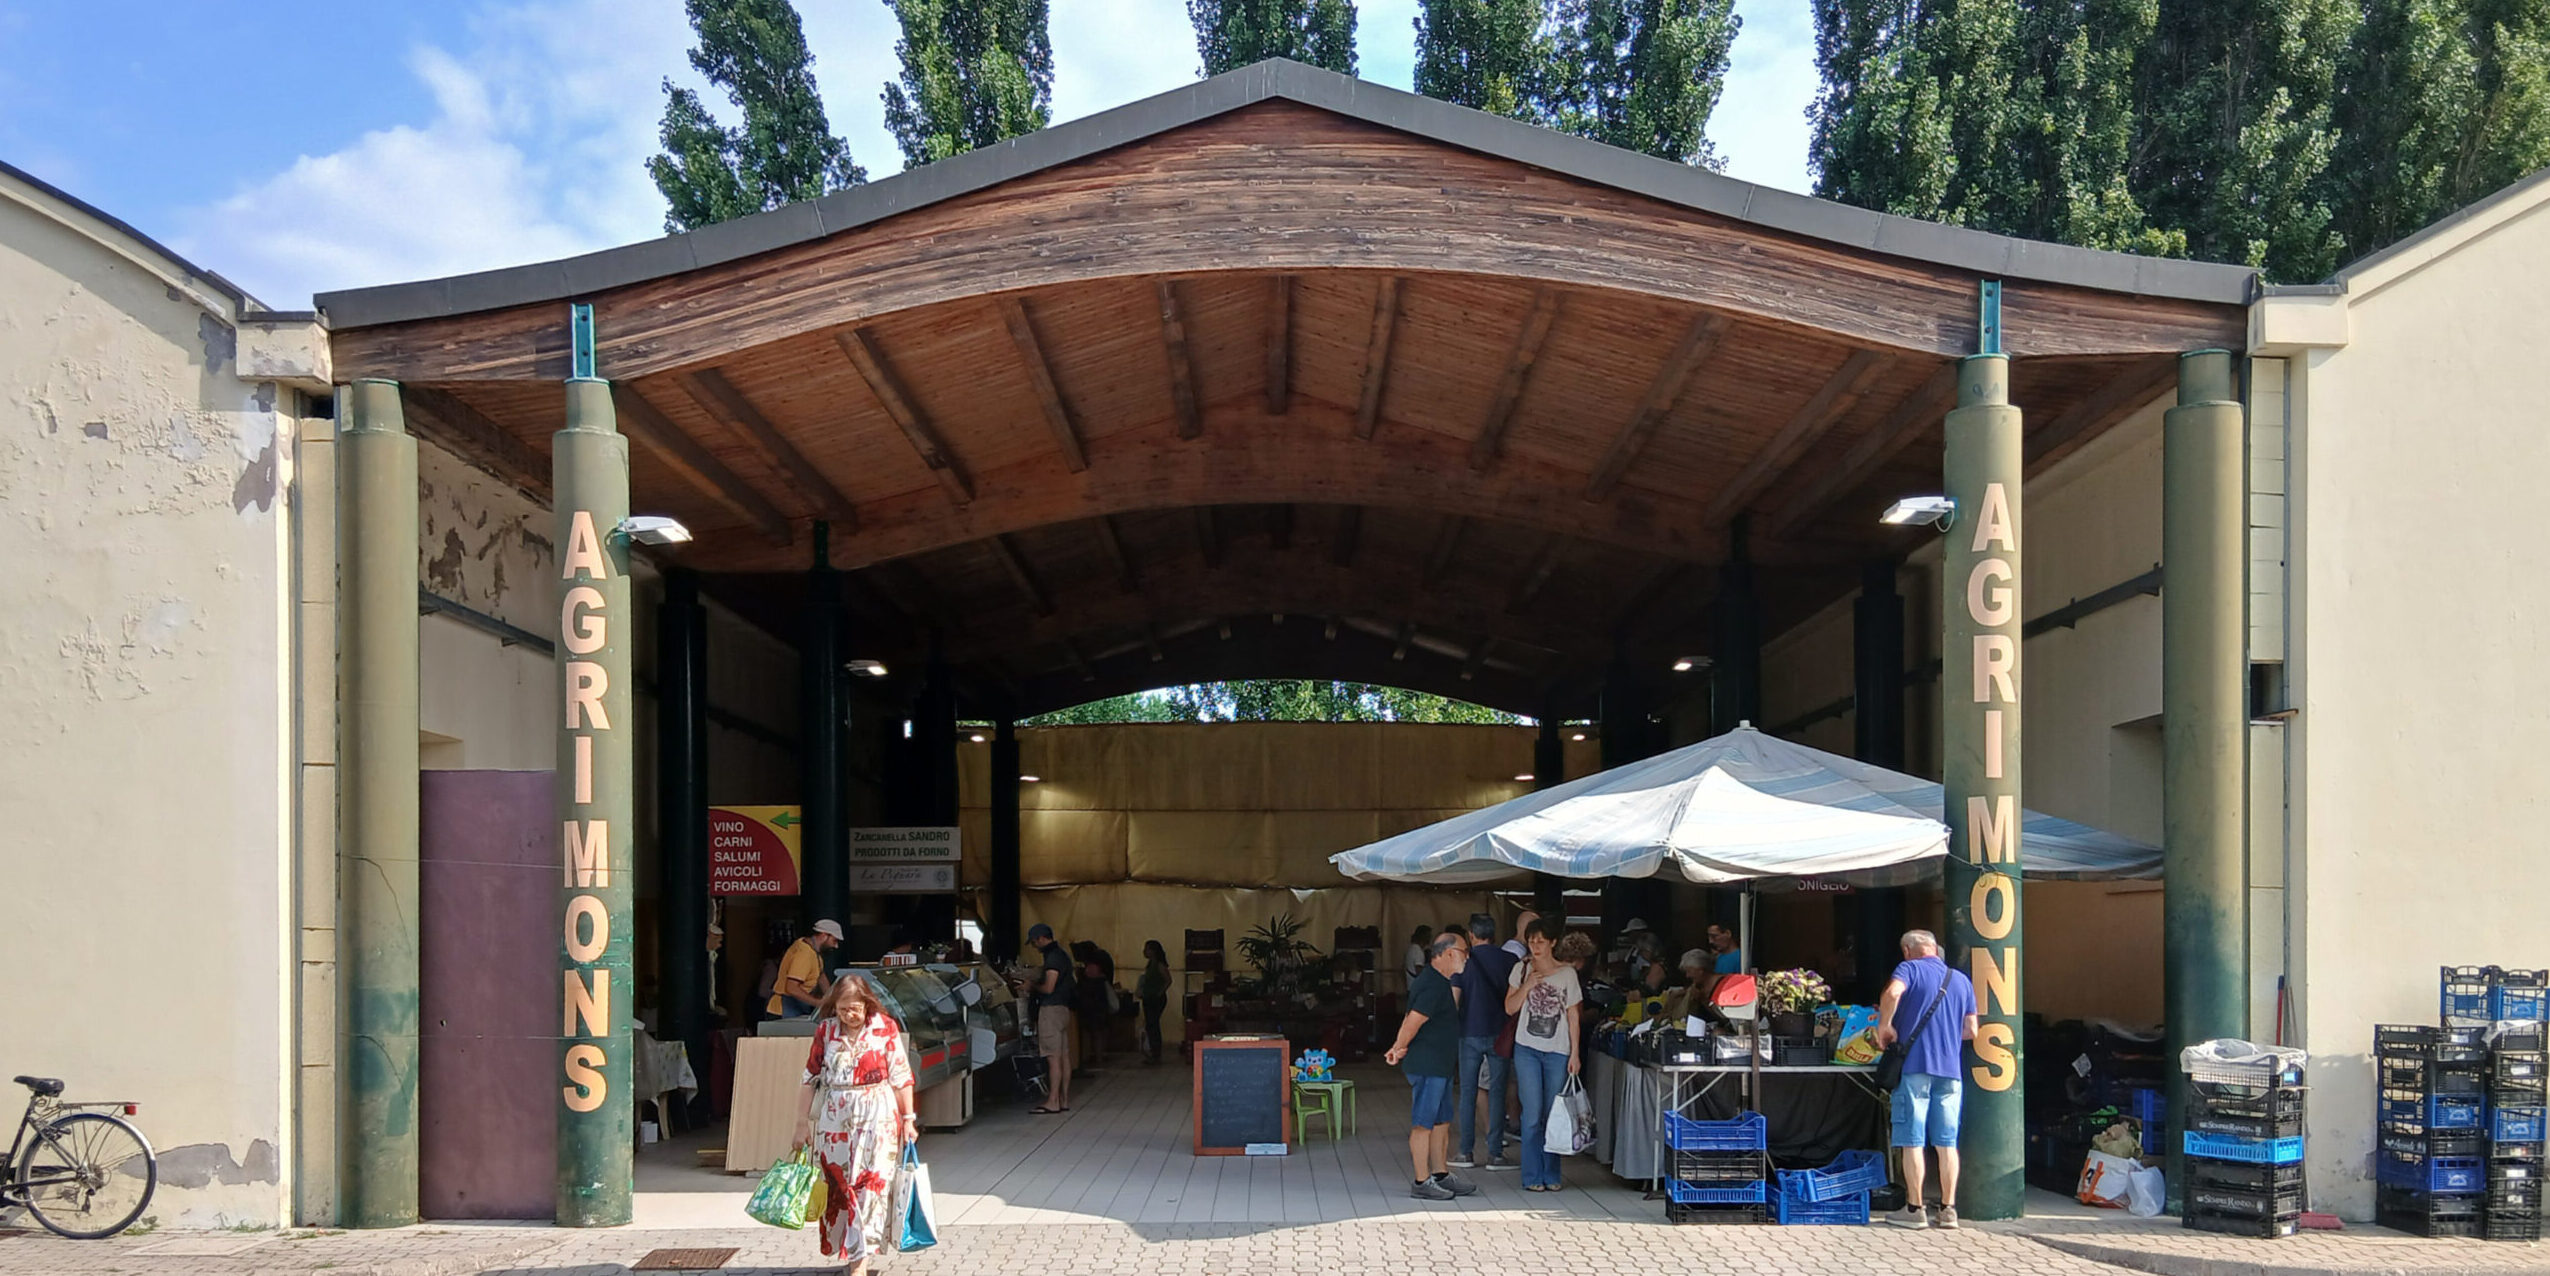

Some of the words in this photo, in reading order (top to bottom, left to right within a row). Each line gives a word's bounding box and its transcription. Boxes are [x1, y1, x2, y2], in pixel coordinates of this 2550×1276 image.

[1967, 482, 2016, 1092] AGRIMONS
[561, 510, 611, 1113] AGRIMONS
[713, 821, 745, 833] VINO
[713, 836, 753, 848] CARNI
[908, 831, 950, 841] SANDRO
[713, 851, 761, 863] SALUMI
[854, 847, 900, 857] PRODOTTI
[903, 847, 917, 857] DA
[918, 847, 950, 857] FORNO
[713, 866, 763, 877] AVICOLI
[713, 880, 781, 892] FORMAGGI
